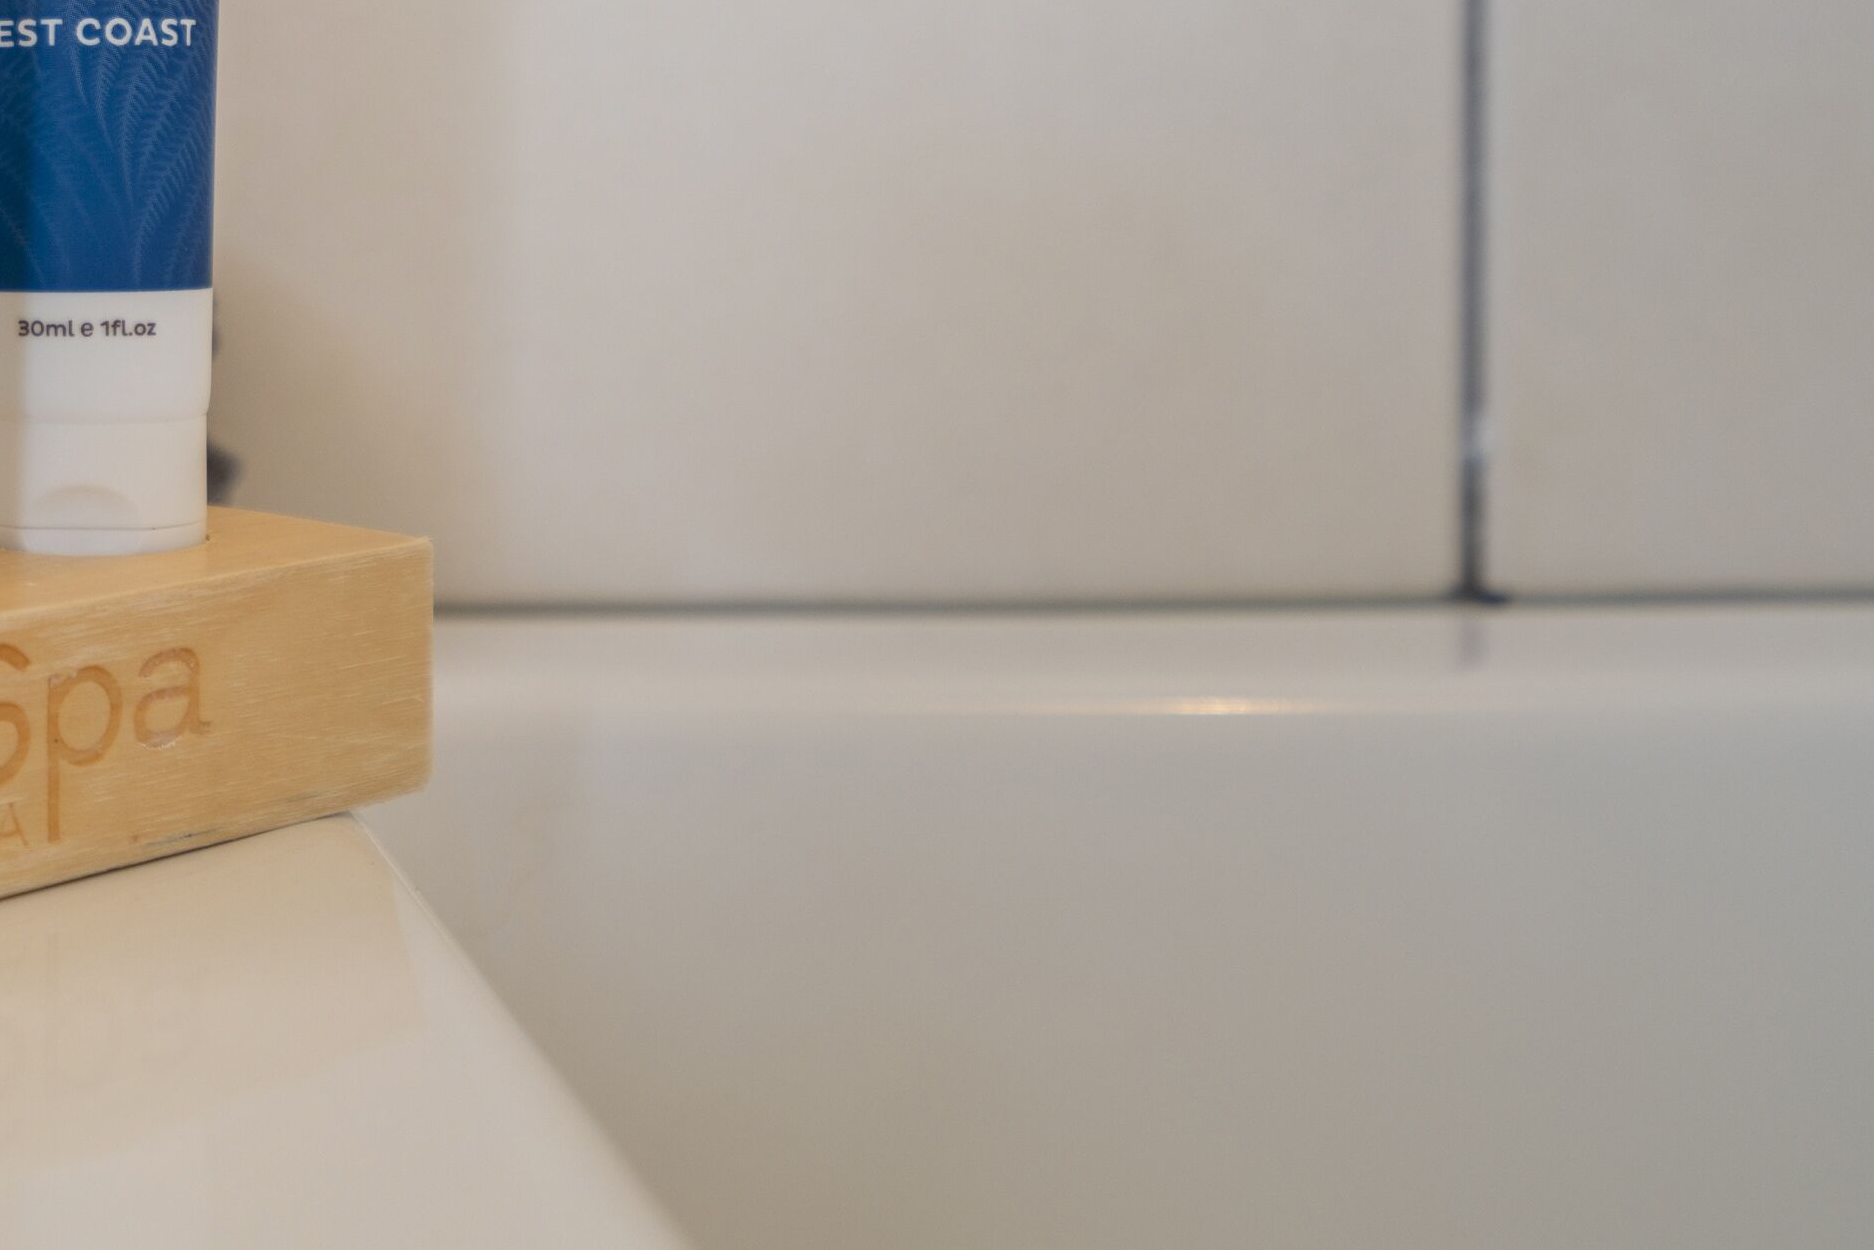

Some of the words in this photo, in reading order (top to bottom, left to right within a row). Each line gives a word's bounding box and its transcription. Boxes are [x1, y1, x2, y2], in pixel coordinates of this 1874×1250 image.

[76, 17, 197, 47] COAST
[18, 320, 75, 337] 30ml
[100, 320, 157, 336] 1fl.oz
